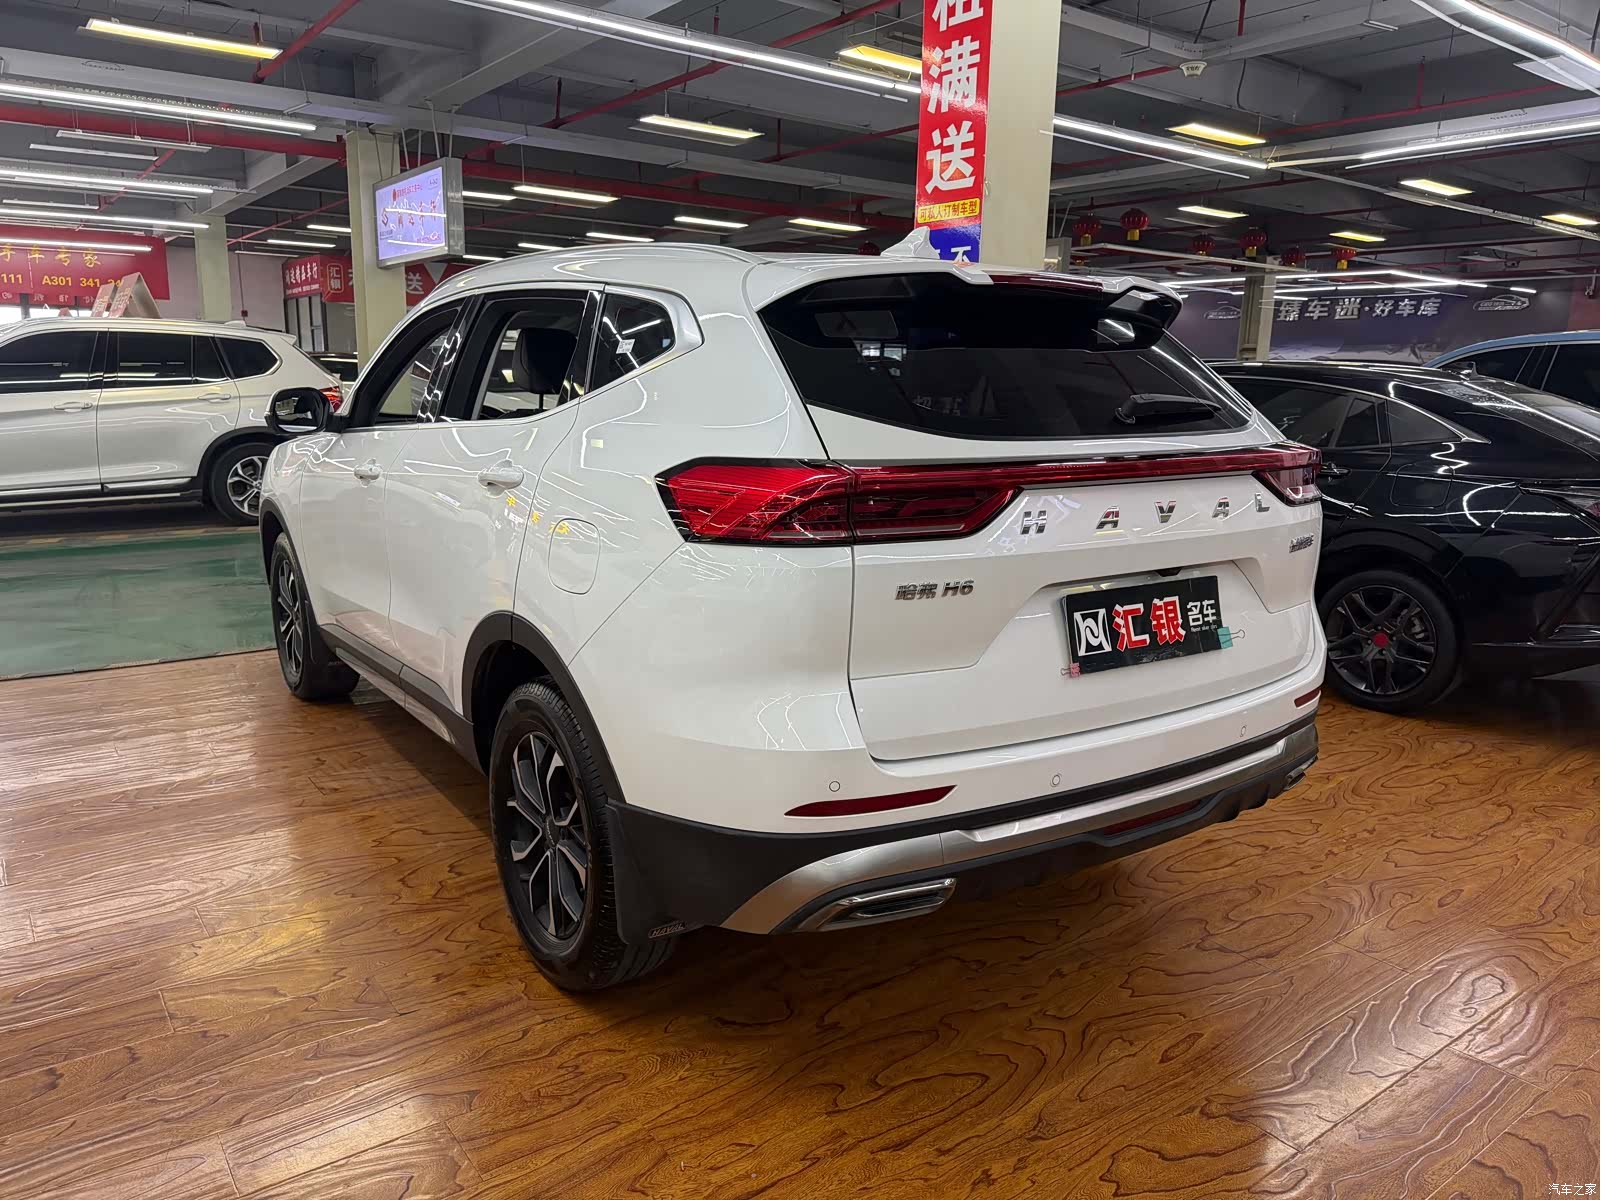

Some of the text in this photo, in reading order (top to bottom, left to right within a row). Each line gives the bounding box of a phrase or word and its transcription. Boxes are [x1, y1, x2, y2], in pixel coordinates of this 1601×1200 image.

[920, 202, 977, 221] 可私人订制车型
[42, 275, 72, 286] A301
[80, 277, 100, 288] 341
[1020, 492, 1270, 535] HAVAL
[941, 579, 974, 597] H6
[1112, 595, 1218, 652] 汇银 名车
